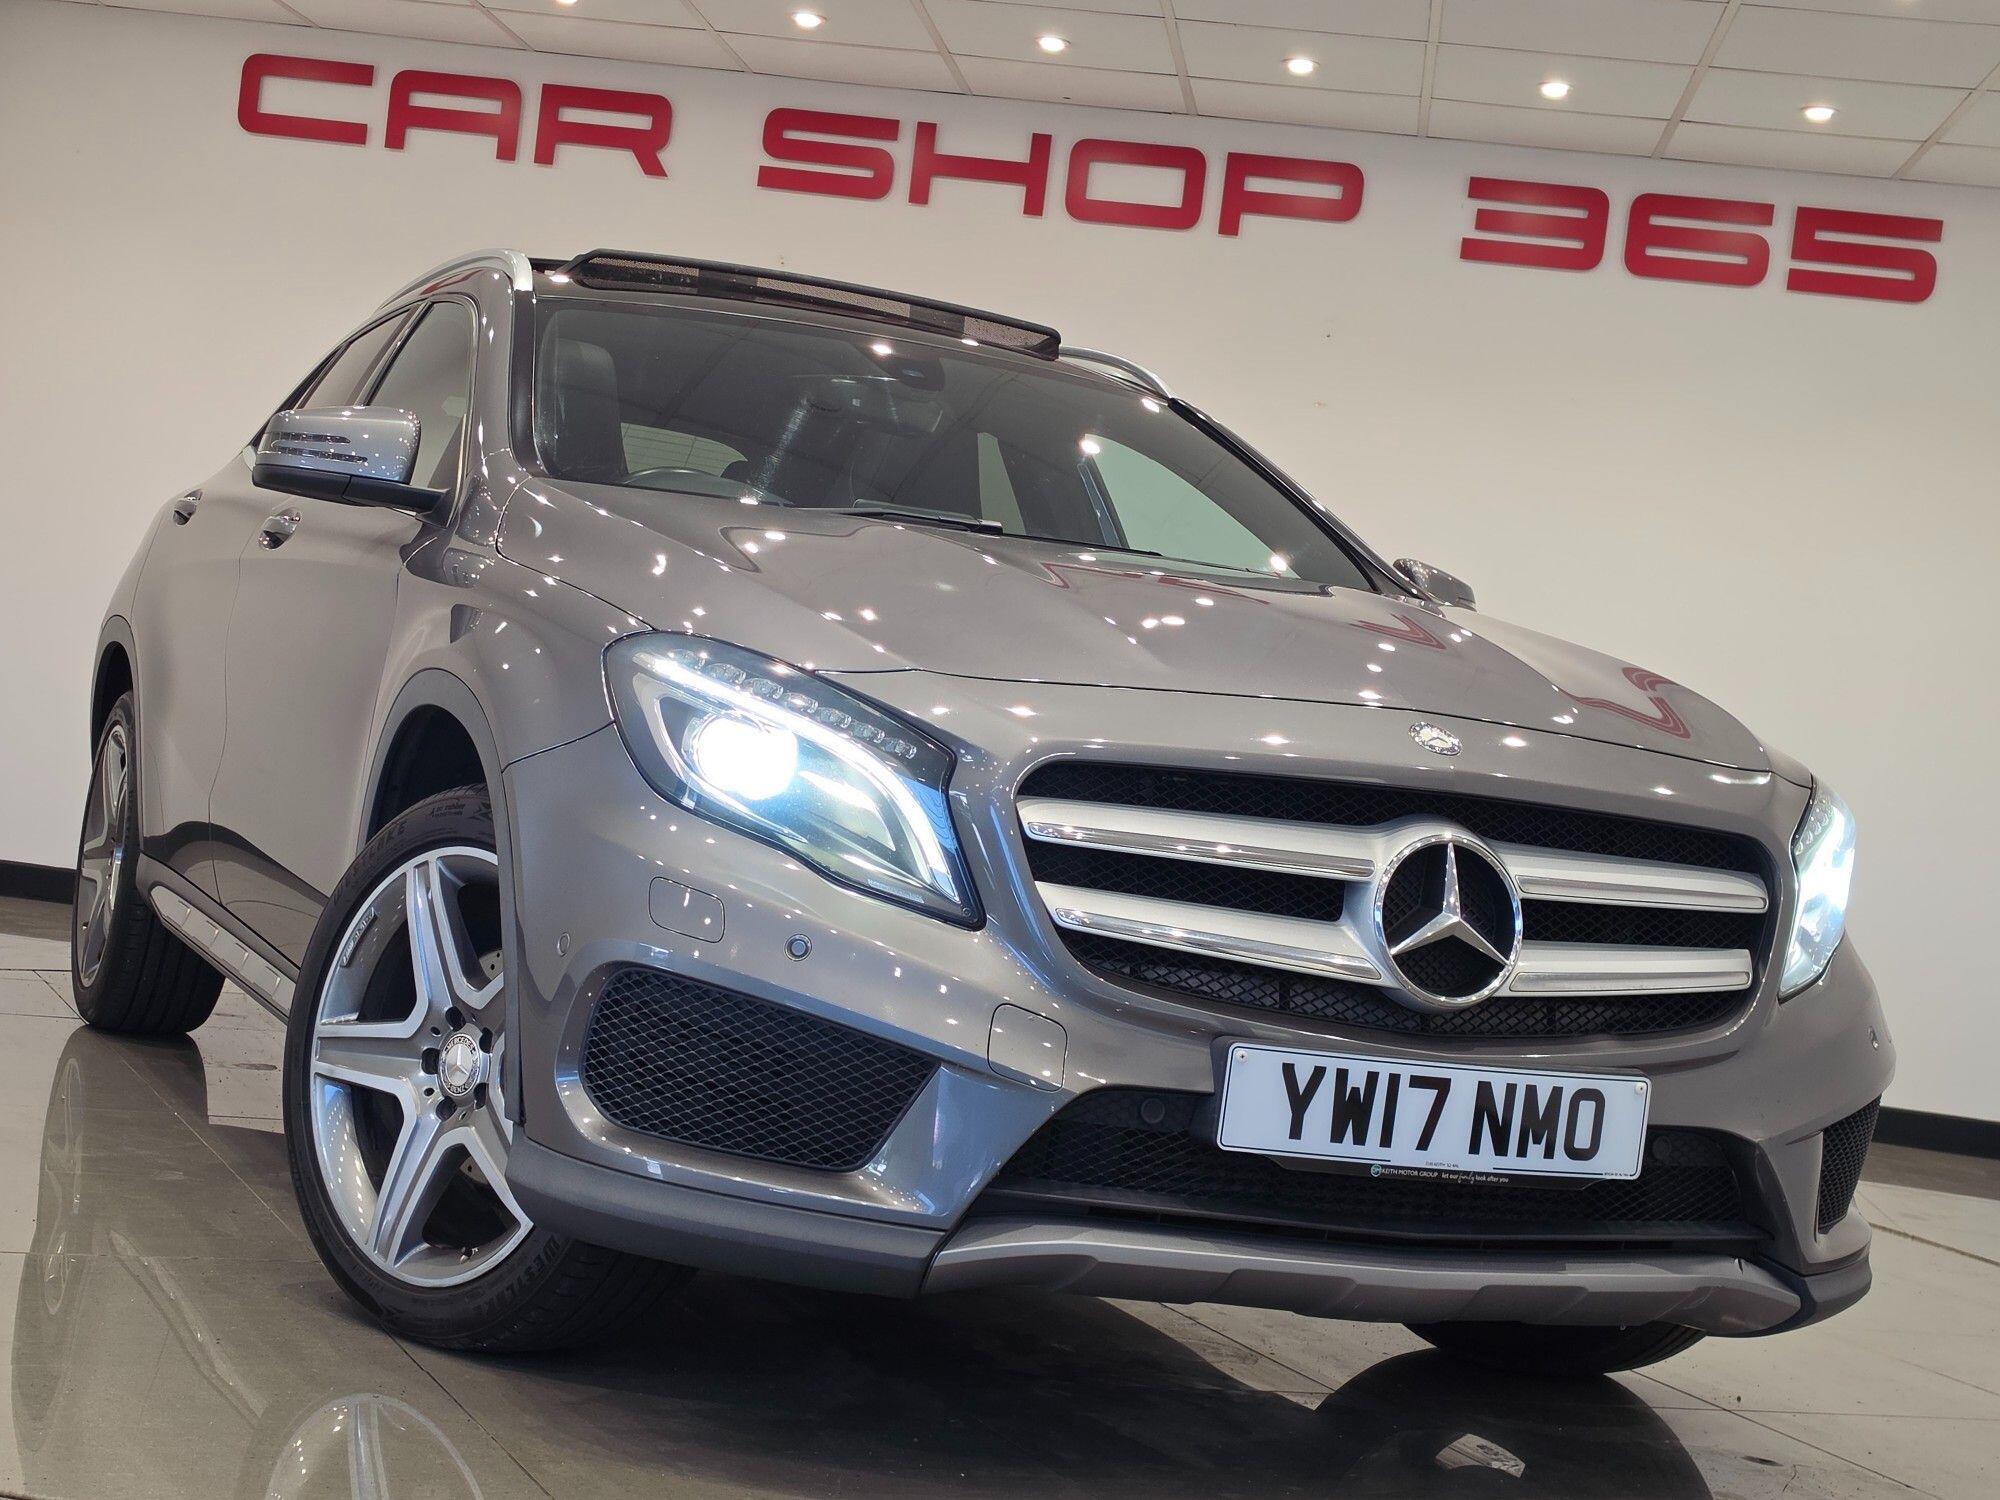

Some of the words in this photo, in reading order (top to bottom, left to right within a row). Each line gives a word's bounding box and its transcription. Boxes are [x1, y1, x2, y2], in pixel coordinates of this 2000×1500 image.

[237, 54, 673, 177] CAR
[757, 108, 1364, 236] SHOP
[1460, 177, 1942, 302] 365
[1281, 1062, 1452, 1152] YW17
[1468, 1080, 1606, 1162] NMO
[1398, 1169, 1419, 1177] MOTOR
